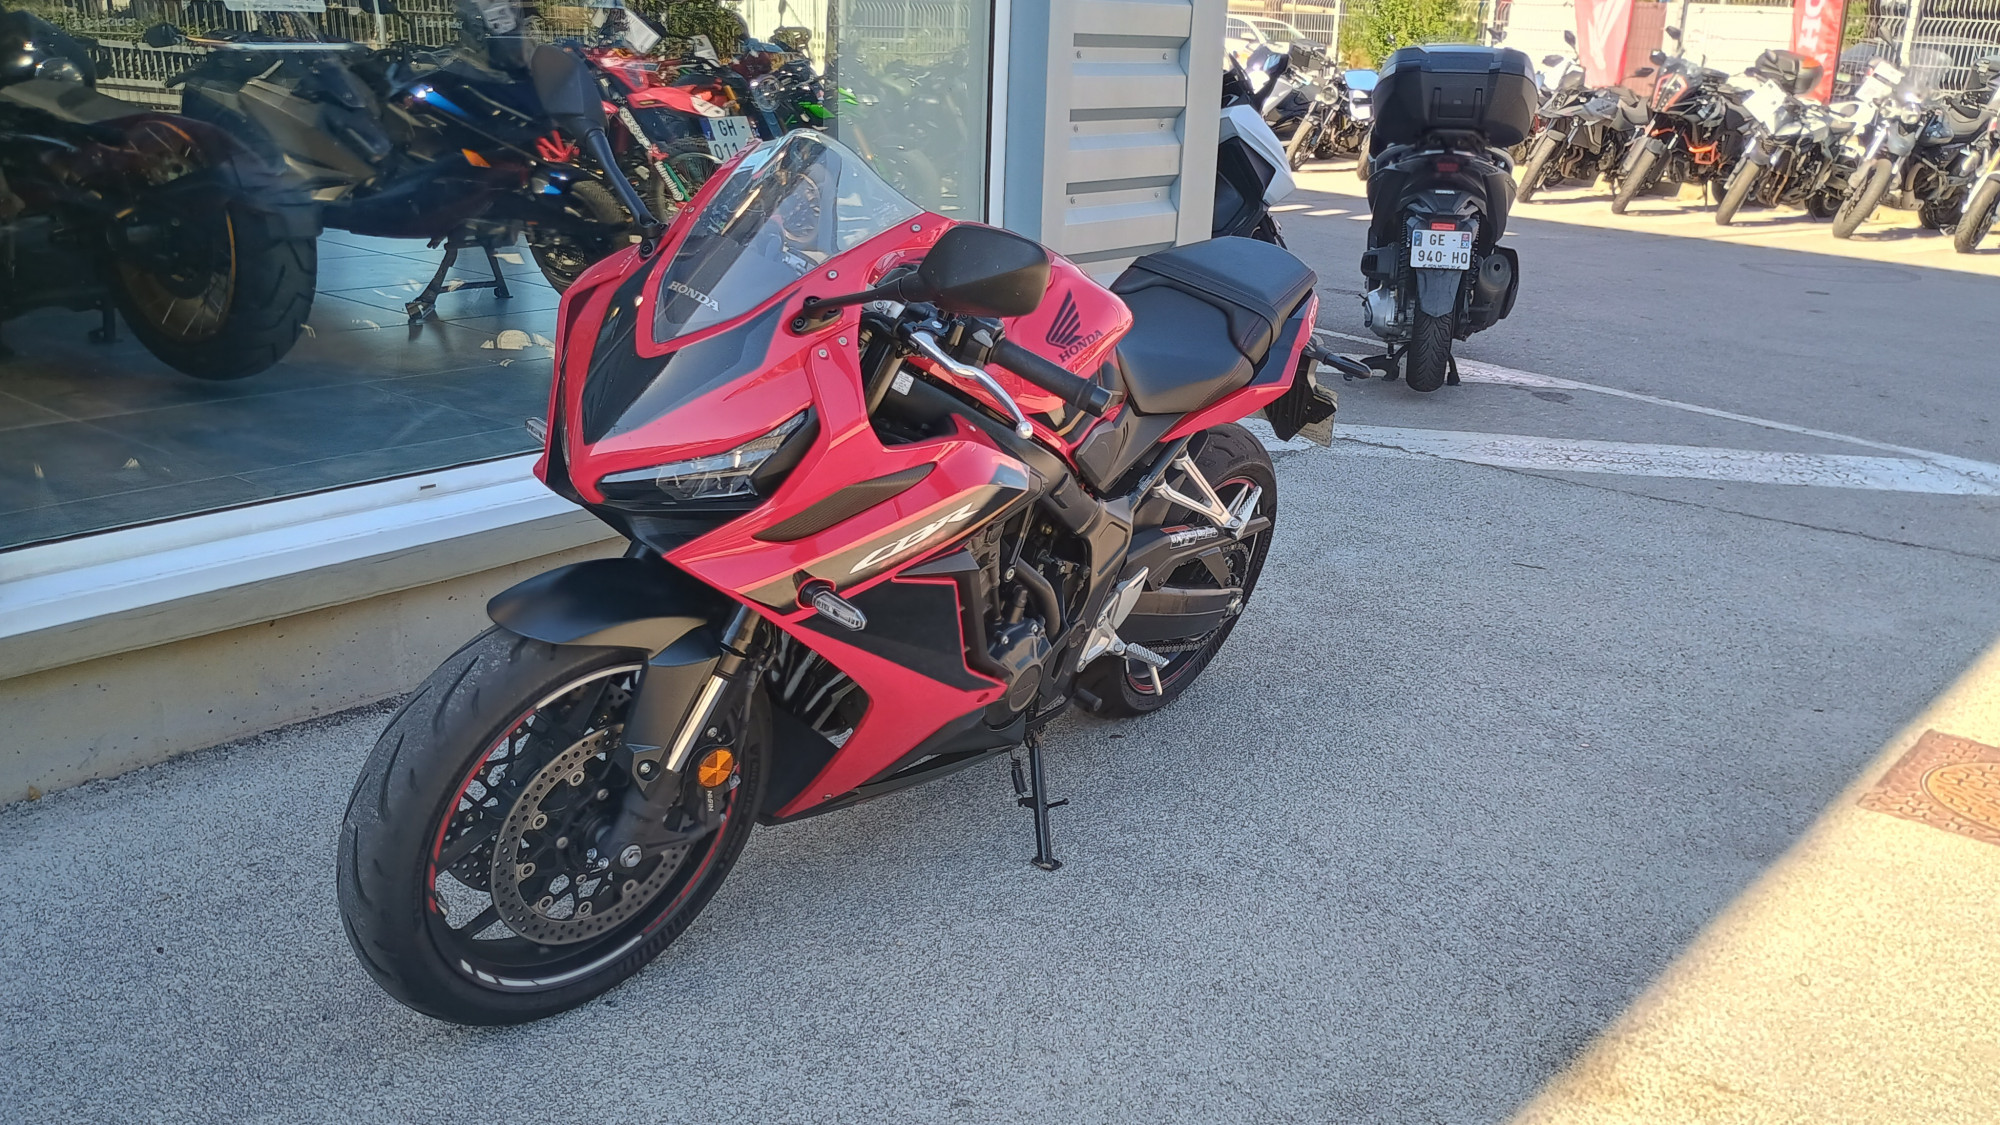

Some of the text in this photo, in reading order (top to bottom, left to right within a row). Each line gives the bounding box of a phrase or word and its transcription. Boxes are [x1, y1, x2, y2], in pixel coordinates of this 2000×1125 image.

[717, 119, 738, 137] GH
[1429, 234, 1446, 247] GE
[667, 280, 720, 312] HONDA
[1058, 329, 1104, 362] HONDA
[849, 502, 980, 575] CBR
